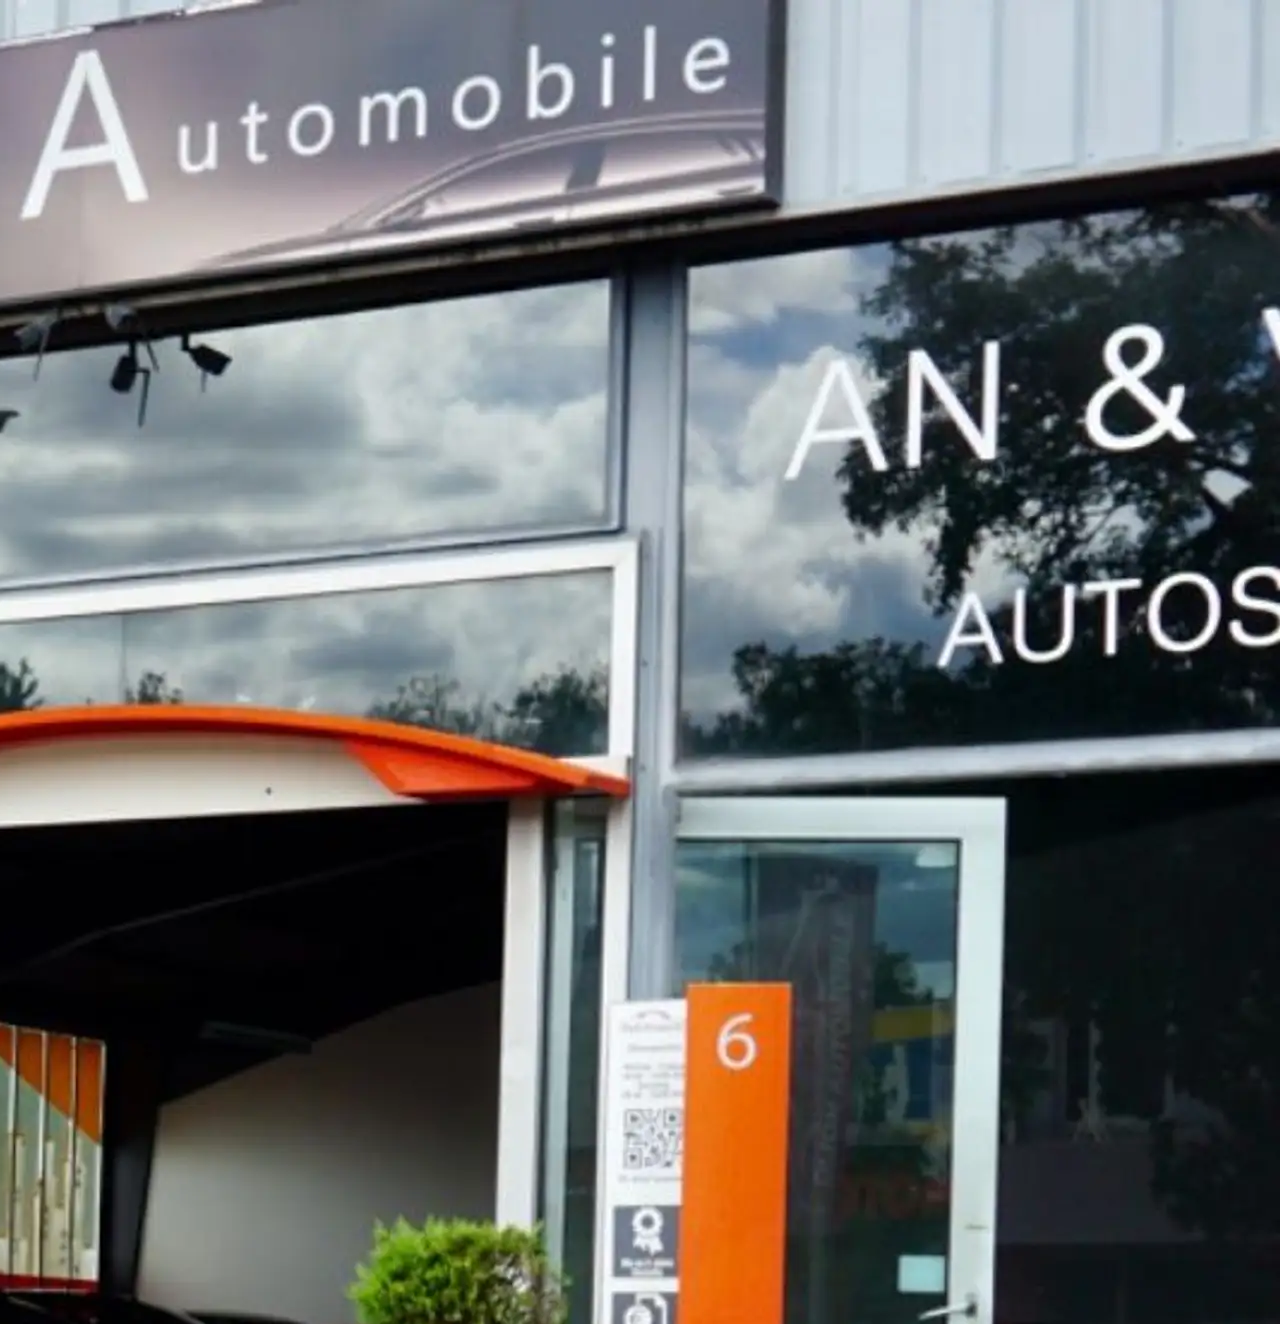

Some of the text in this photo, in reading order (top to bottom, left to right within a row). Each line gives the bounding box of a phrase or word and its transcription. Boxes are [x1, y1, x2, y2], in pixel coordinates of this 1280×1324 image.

[19, 26, 732, 219] Automobile
[783, 324, 1196, 480] AN &
[938, 565, 1280, 668] AUTOS
[716, 1012, 758, 1071] 6
